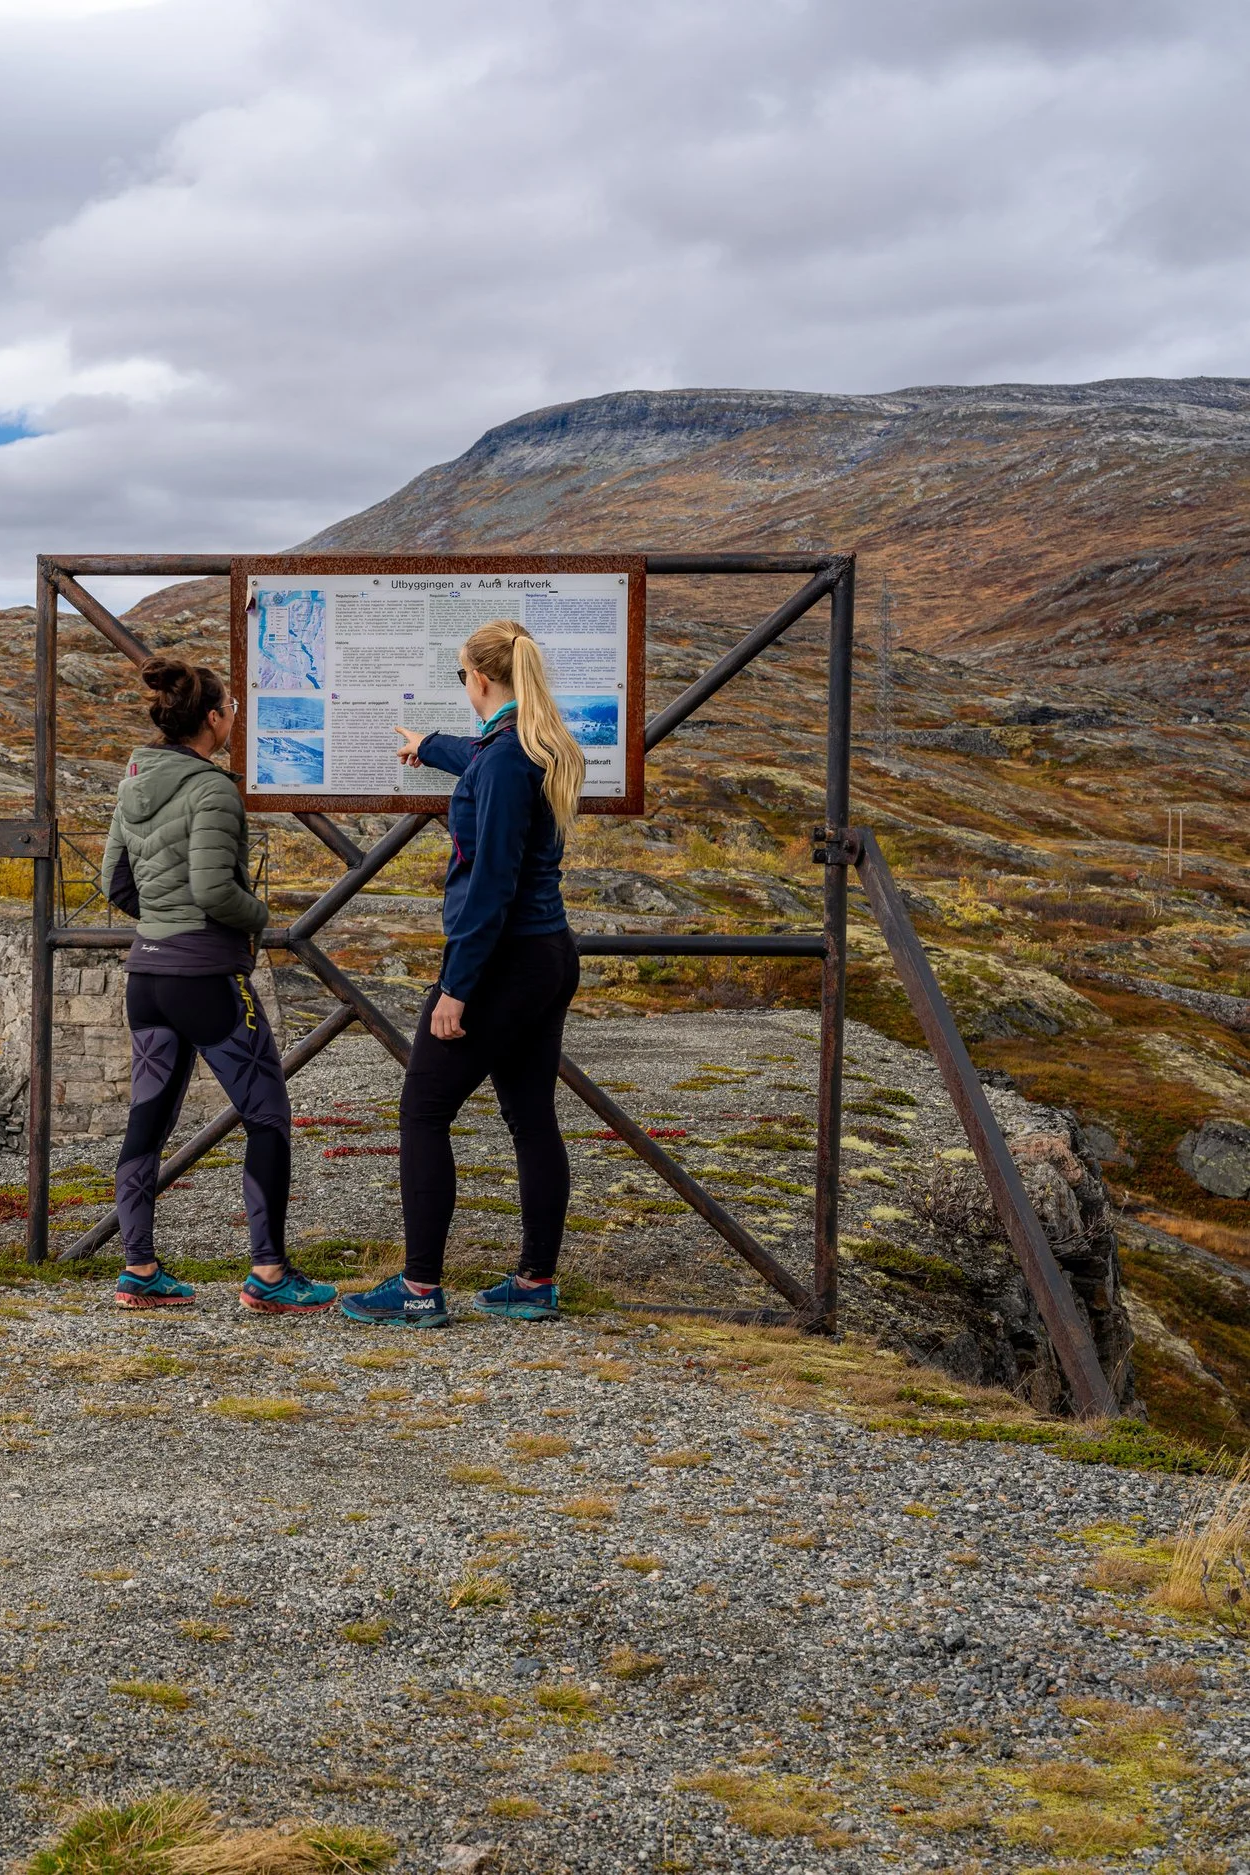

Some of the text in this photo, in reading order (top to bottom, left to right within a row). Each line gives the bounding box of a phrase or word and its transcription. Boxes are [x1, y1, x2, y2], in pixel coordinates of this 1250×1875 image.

[391, 579, 454, 590] Utbyggingen
[478, 580, 502, 588] Aura
[507, 580, 552, 588] kraftverk
[404, 1298, 436, 1310] HOKA
